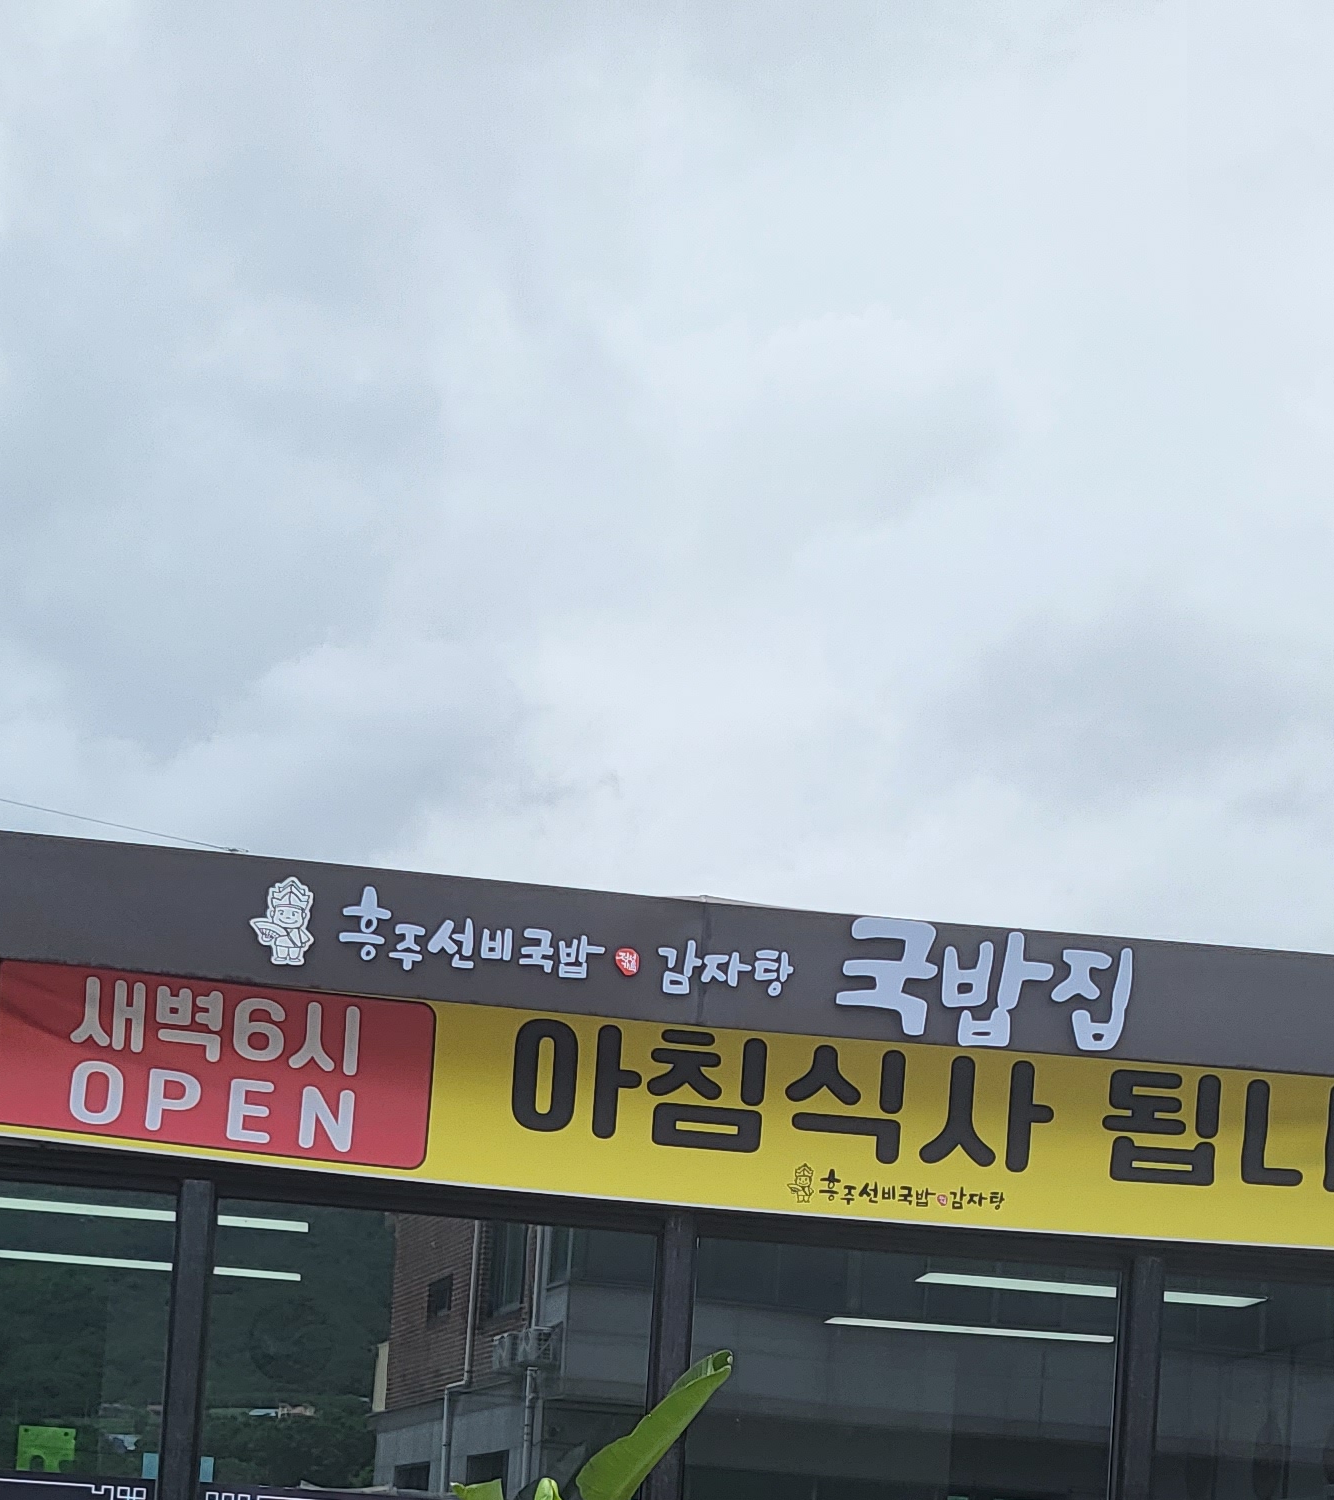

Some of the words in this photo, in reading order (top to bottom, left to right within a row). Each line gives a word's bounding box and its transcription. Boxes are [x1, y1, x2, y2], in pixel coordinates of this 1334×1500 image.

[338, 885, 606, 979] 흥주선비국밥
[657, 940, 795, 998] 감자탕
[835, 916, 1134, 1052] 국밥집
[70, 975, 361, 1076] 새벽6시
[69, 1060, 355, 1153] OPEN
[512, 1018, 1055, 1173] 아침식사
[819, 1168, 936, 1207] 흥주선비국밥
[950, 1186, 1005, 1210] 감자탕
